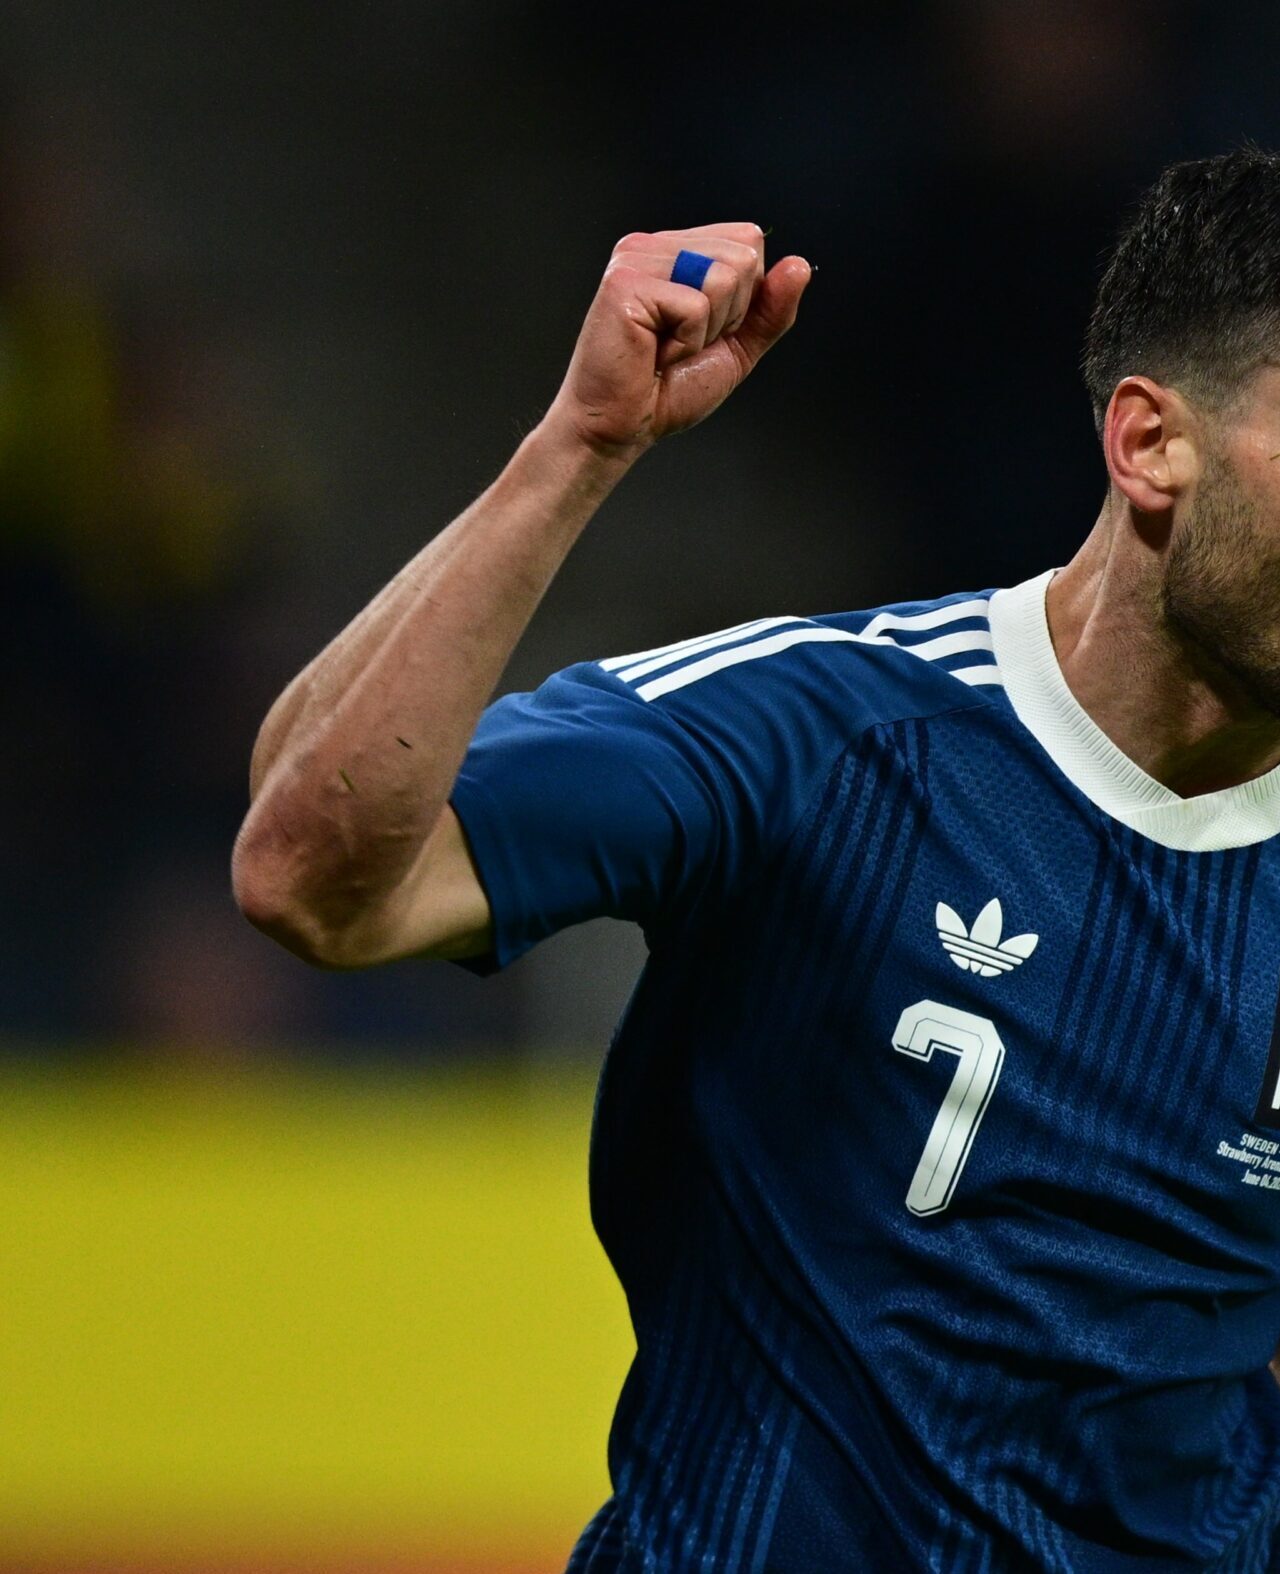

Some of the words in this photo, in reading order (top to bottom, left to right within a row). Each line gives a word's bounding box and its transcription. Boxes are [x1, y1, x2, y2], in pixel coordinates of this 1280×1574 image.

[892, 999, 1006, 1217] 7
[1217, 1141, 1264, 1169] Strawberry
[1240, 1133, 1279, 1155] SWEDEN
[1241, 1169, 1261, 1185] June
